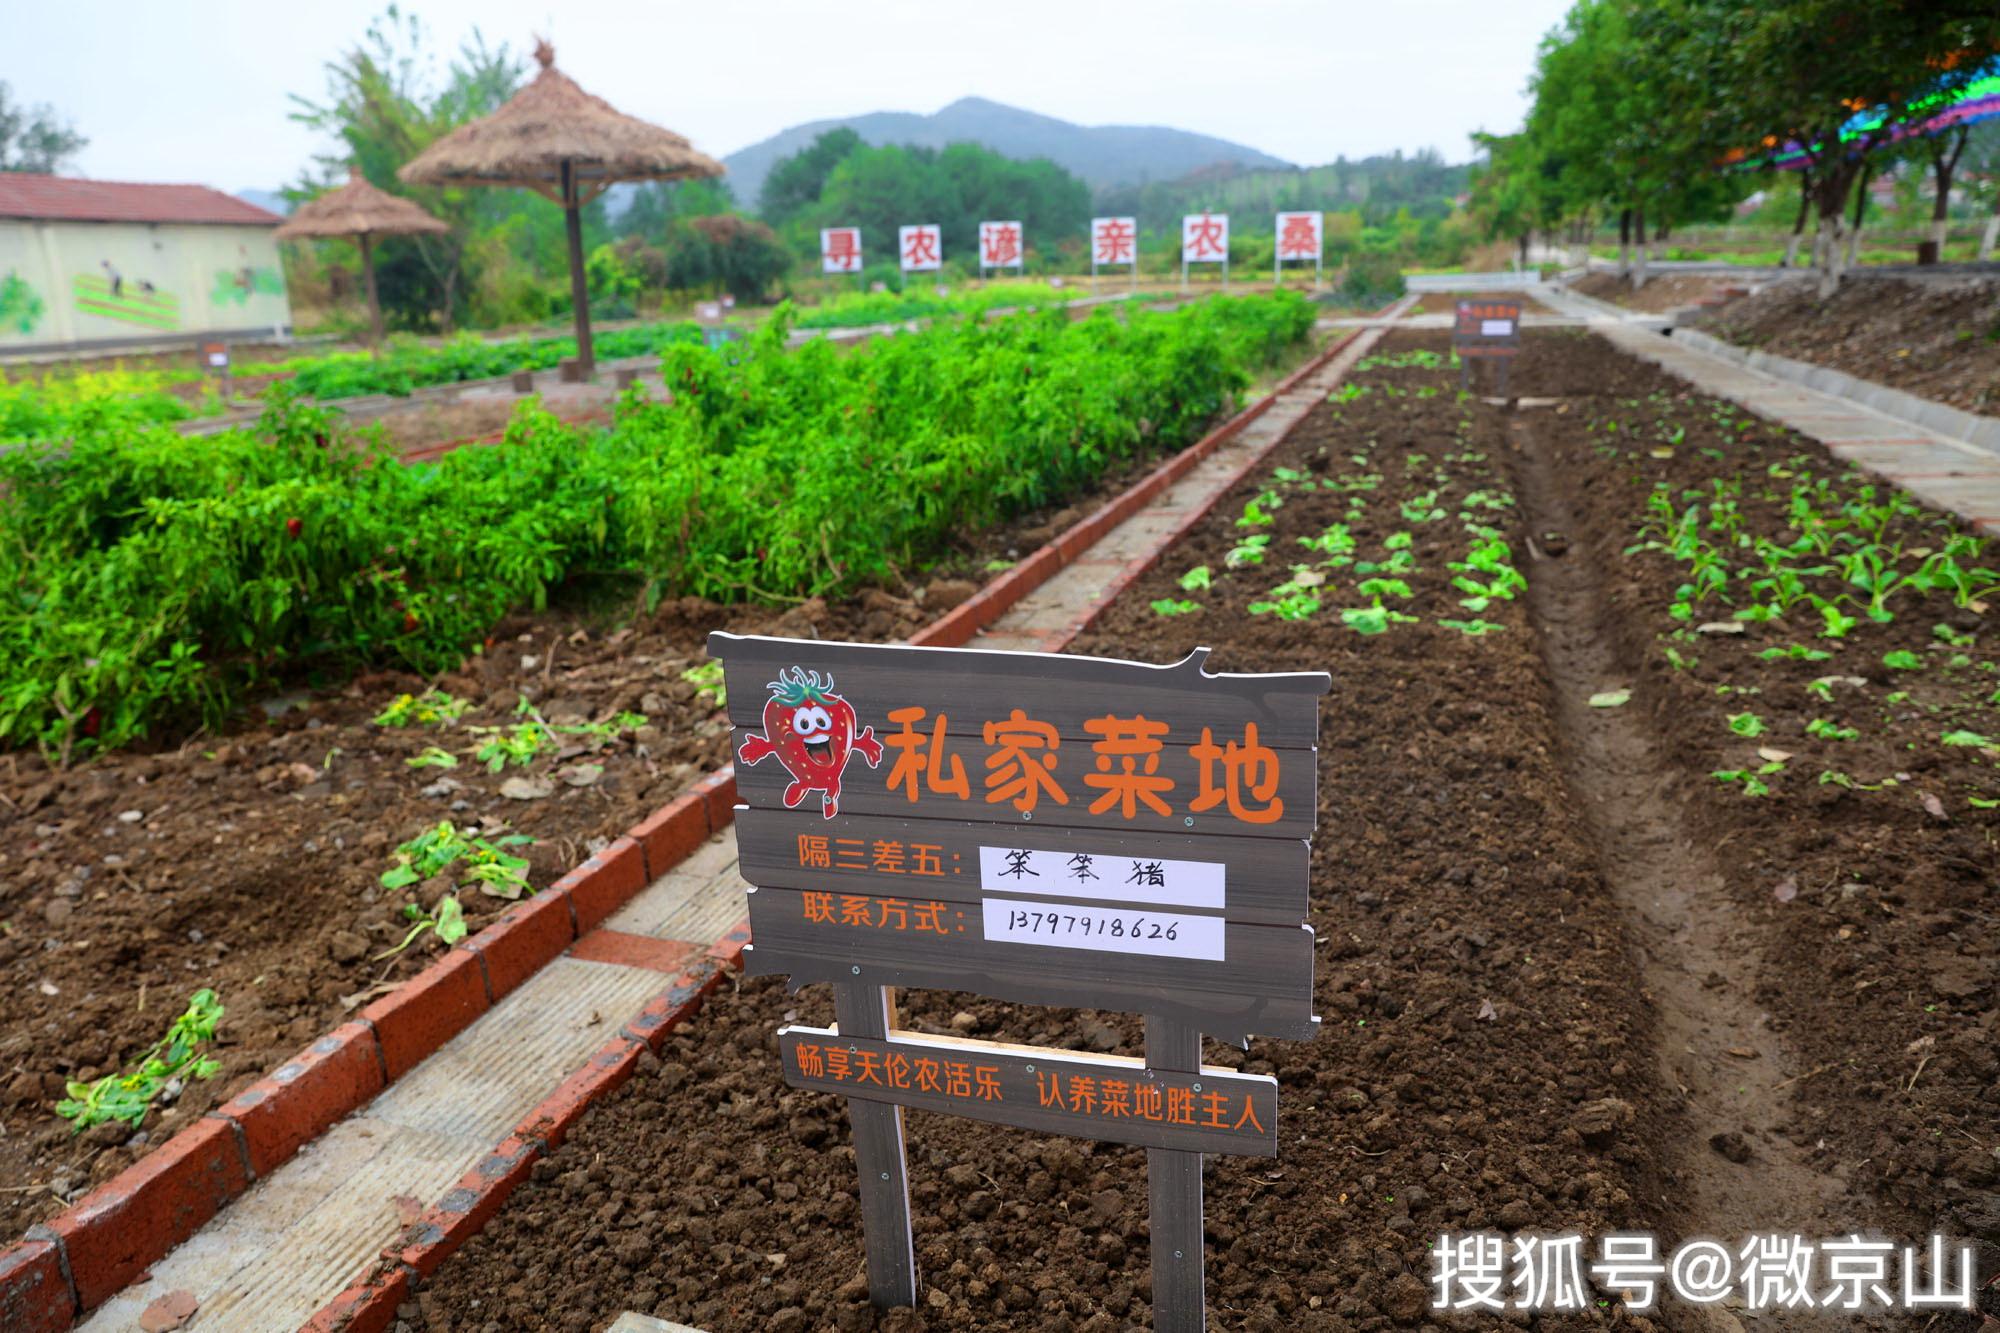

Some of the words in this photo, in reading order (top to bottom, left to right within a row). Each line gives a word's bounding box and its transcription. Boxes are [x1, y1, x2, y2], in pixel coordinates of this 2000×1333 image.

[884, 706, 1284, 824] 私家菜地
[1008, 909, 1180, 942] 13797918626
[796, 1043, 1003, 1101] 畅享天伦农活乐
[1036, 1071, 1265, 1134] 认养菜地胜主人
